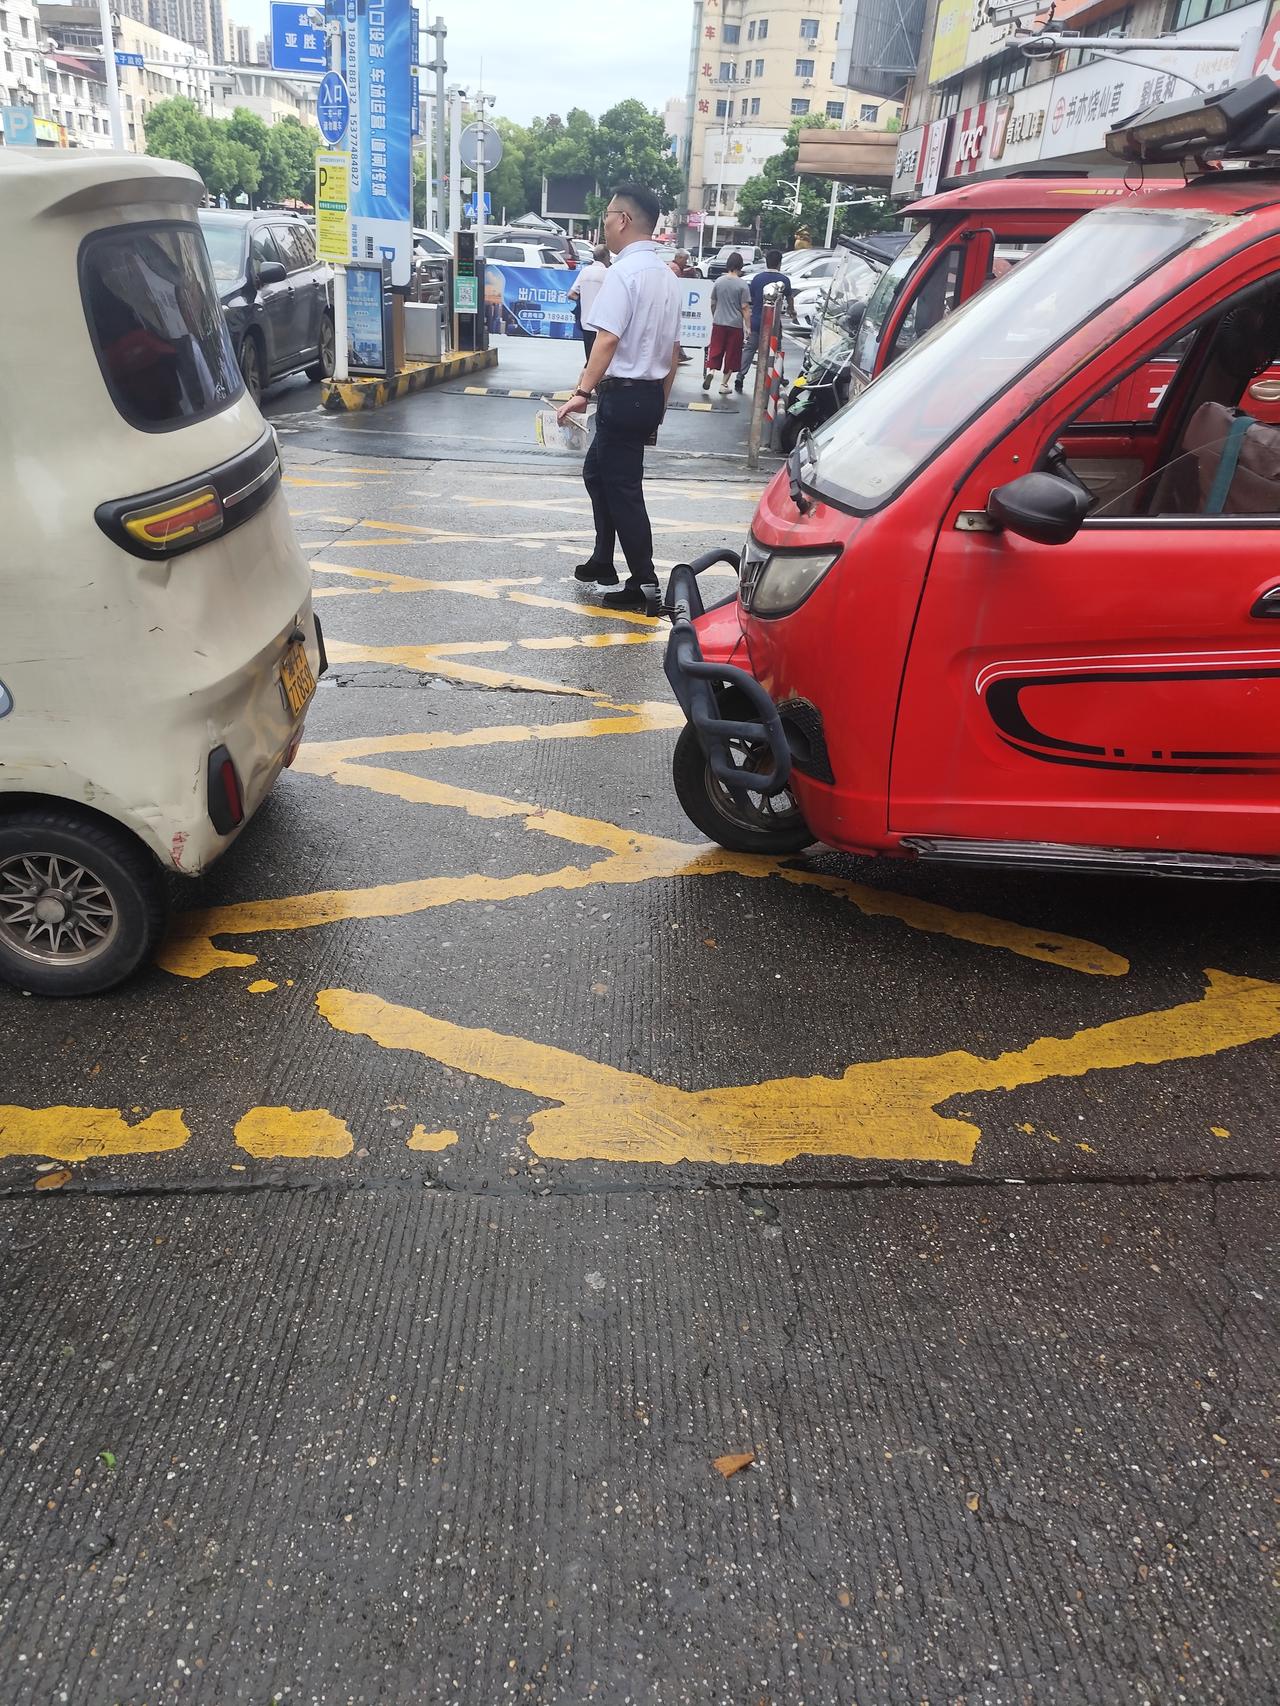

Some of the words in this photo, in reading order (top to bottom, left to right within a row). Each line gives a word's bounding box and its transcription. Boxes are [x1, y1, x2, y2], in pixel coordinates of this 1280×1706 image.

[284, 32, 326, 50] 亚胜
[348, 27, 357, 104] 18948188132
[323, 83, 342, 104] 入口
[1066, 82, 1124, 128] 书亦烧仙草
[10, 112, 28, 138] P
[958, 125, 985, 162] KFC
[319, 168, 328, 197] P
